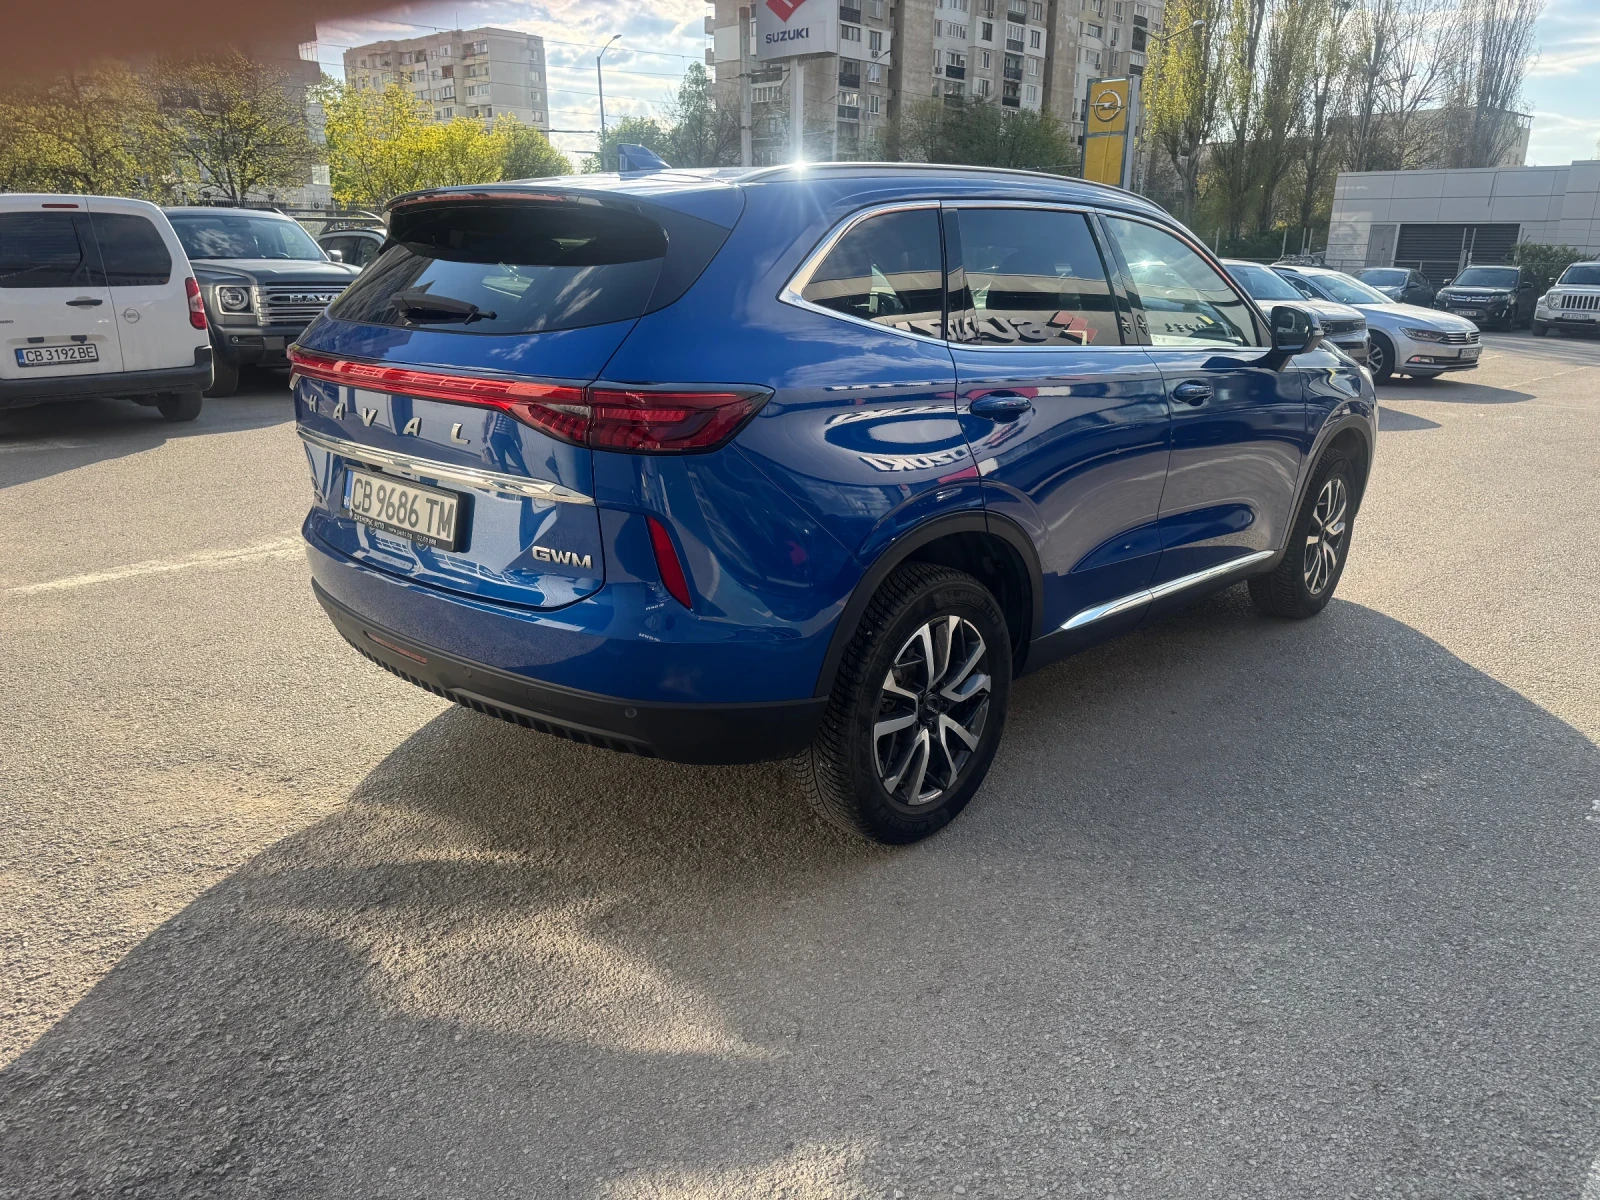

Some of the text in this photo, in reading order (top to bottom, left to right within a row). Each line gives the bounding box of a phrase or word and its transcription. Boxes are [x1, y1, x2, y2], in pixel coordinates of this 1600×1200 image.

[765, 27, 809, 44] SUZUKI
[26, 347, 95, 362] CB 3192 BE
[308, 394, 471, 444] HAVAL
[352, 478, 455, 538] CB 9686 TM
[532, 546, 592, 569] GWM
